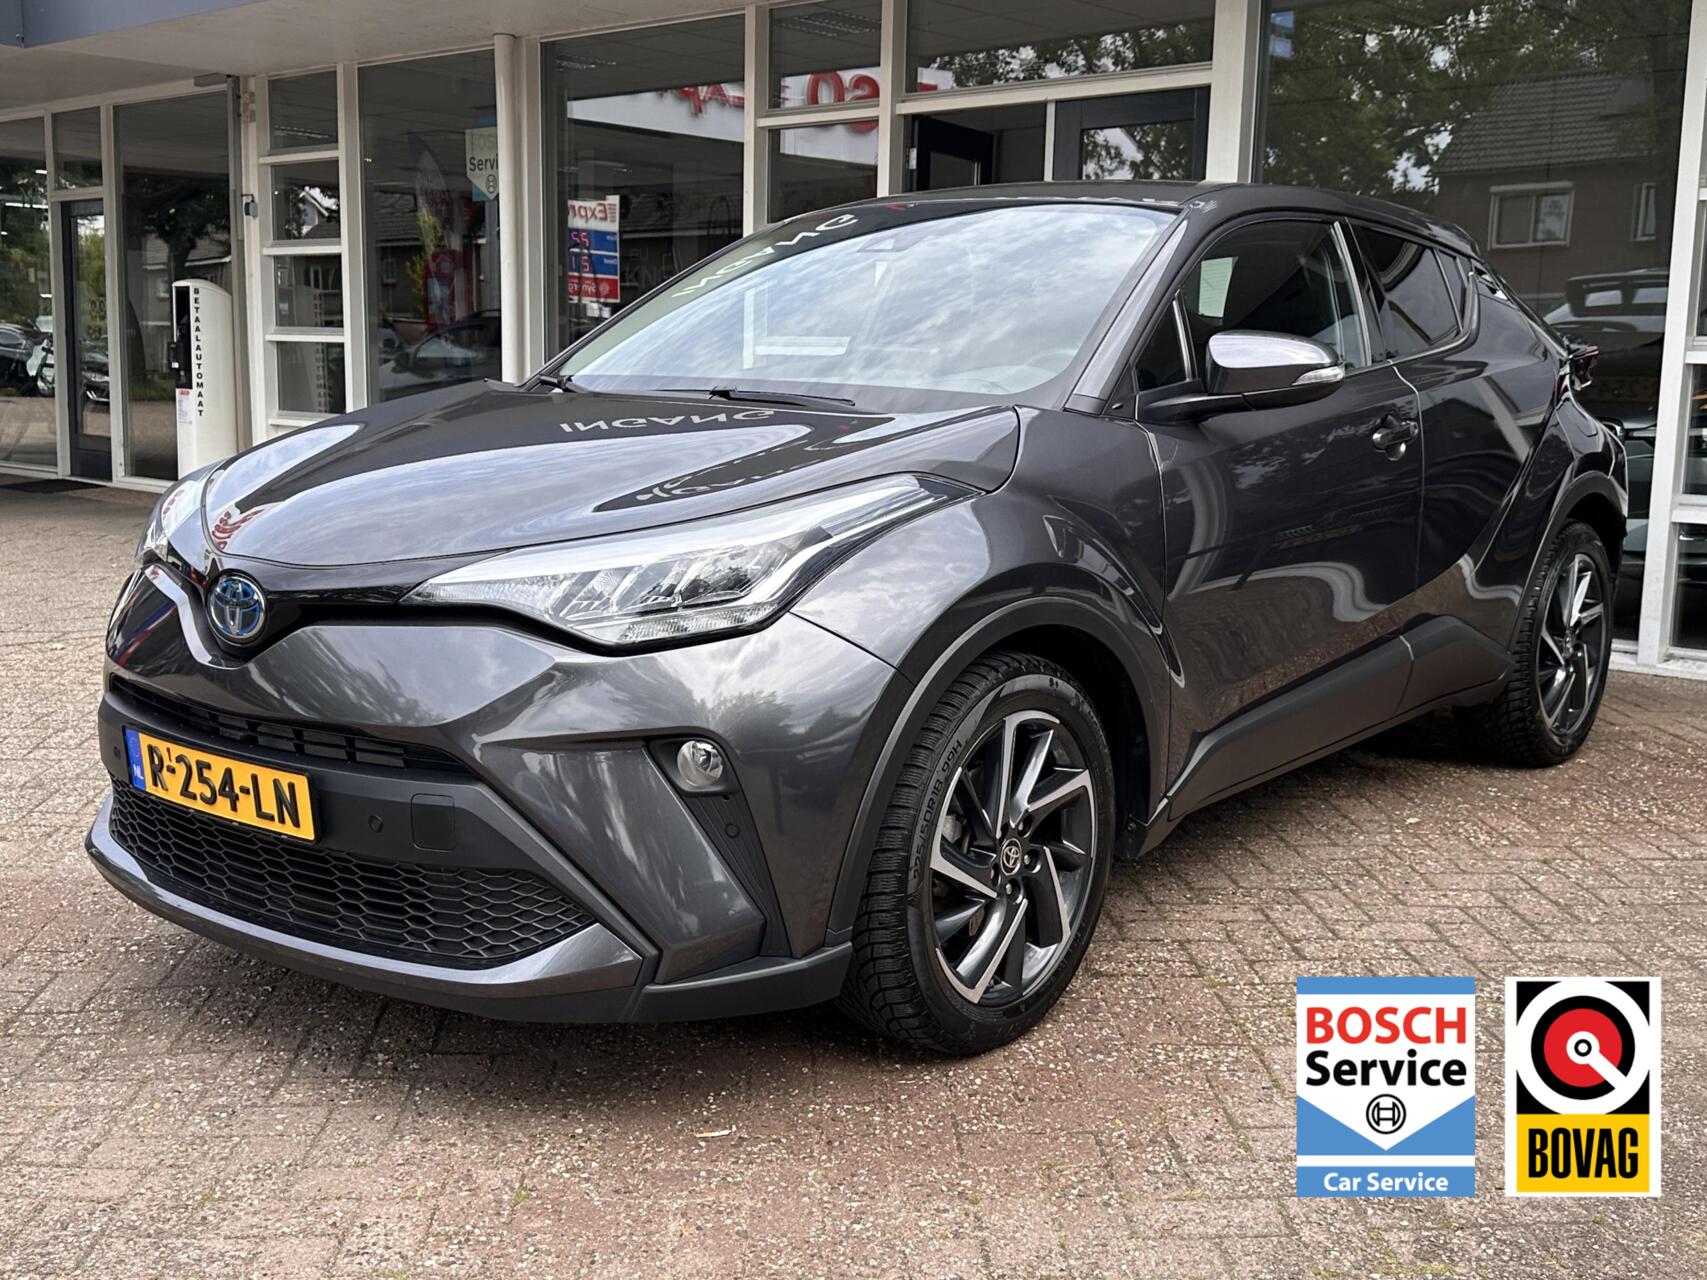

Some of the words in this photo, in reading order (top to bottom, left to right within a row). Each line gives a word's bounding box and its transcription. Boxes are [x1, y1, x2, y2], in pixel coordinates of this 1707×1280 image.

[193, 287, 204, 417] BETAALAUTOMAAT
[133, 765, 144, 779] NL
[147, 743, 301, 828] R-254-LN
